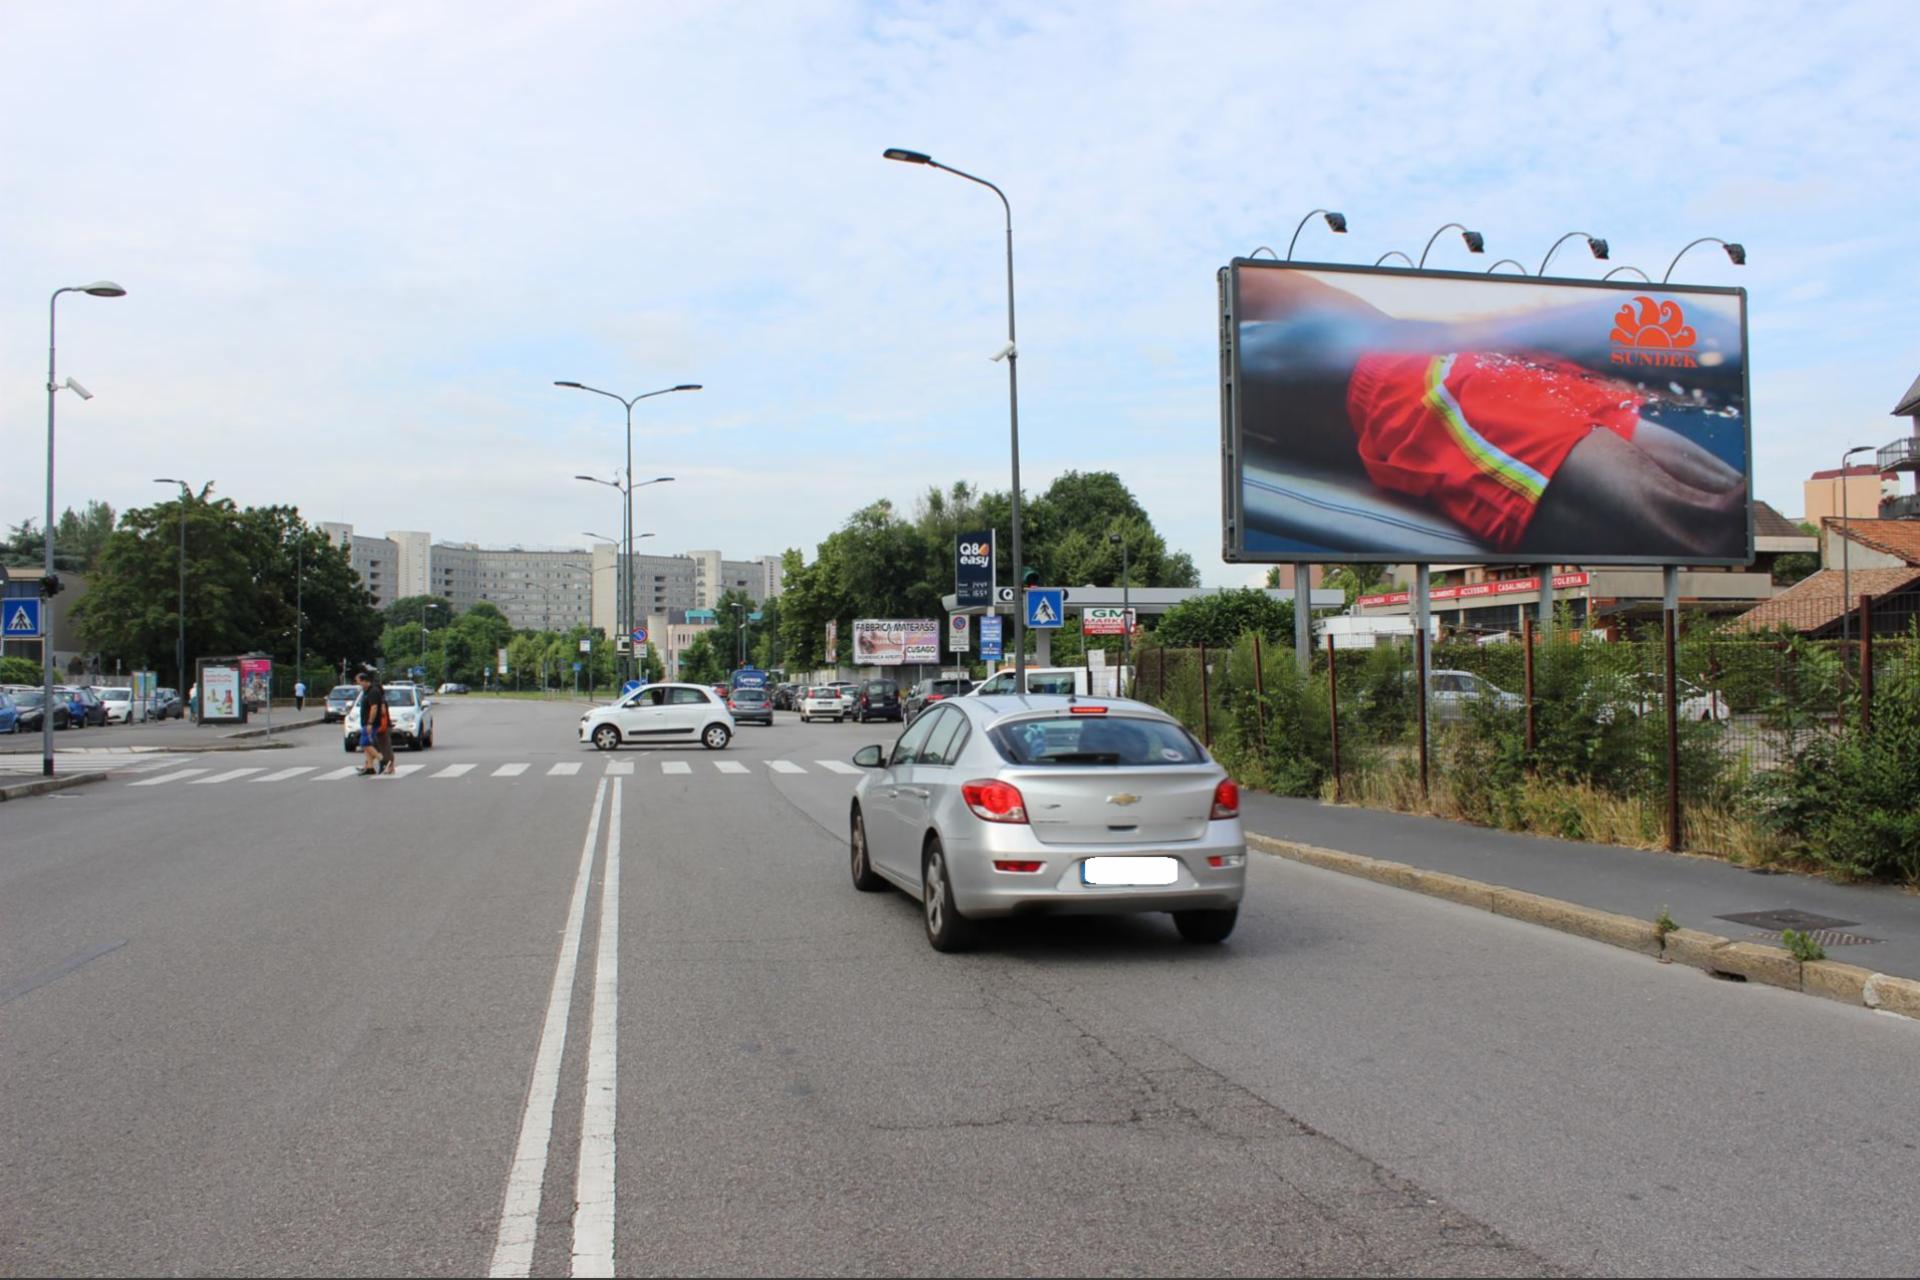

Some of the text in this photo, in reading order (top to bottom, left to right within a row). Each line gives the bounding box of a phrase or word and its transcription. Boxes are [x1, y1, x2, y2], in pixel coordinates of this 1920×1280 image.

[1610, 351, 1698, 369] SUNDEK
[960, 542, 980, 555] Q8
[960, 555, 990, 568] easy
[856, 623, 891, 632] FABBRICA
